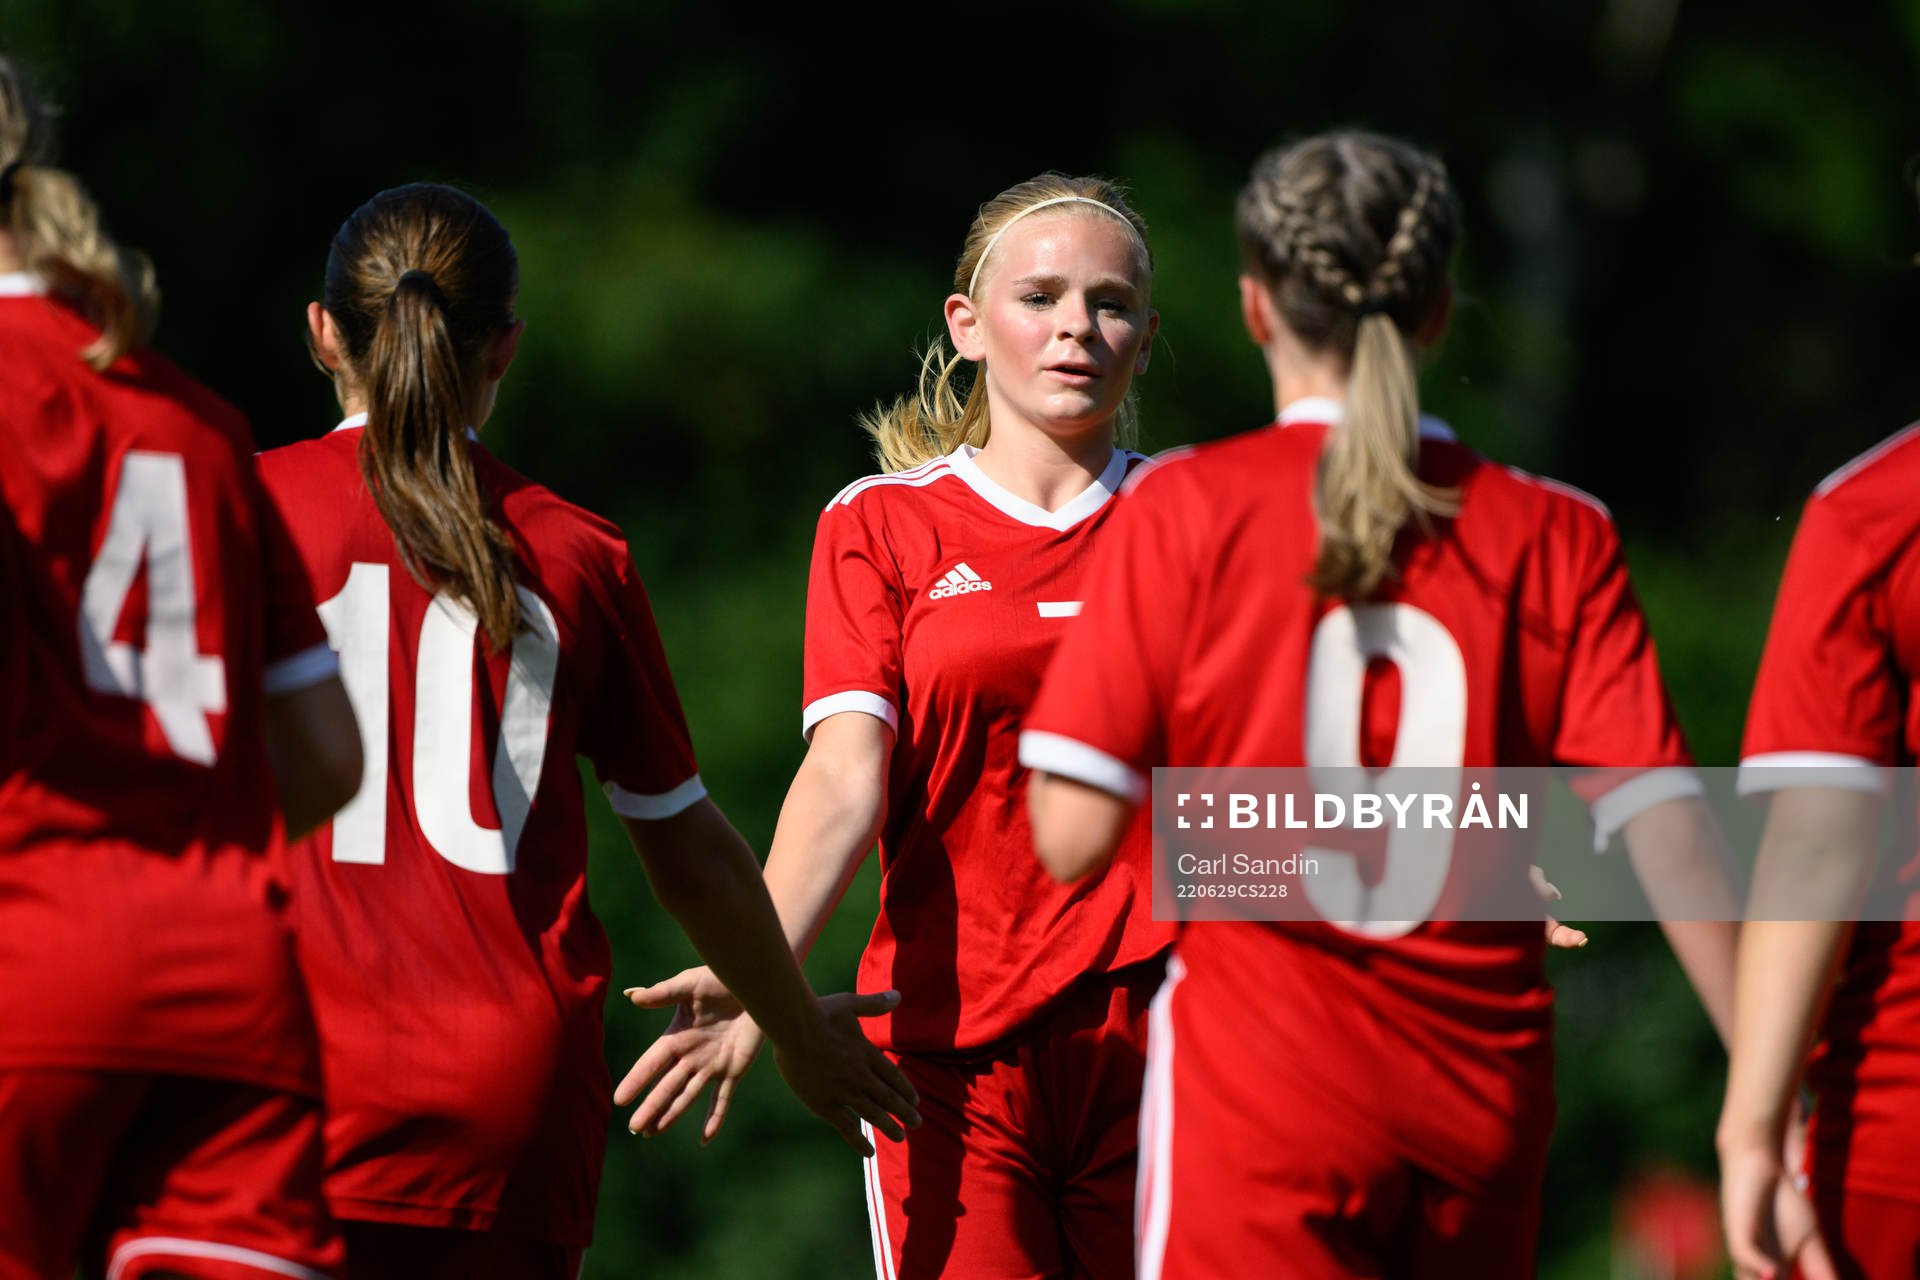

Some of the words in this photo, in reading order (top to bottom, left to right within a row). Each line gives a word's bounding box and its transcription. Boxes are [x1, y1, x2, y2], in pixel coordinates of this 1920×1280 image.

[80, 452, 227, 767] 4
[317, 562, 560, 873] 10
[929, 581, 992, 600] adidas
[1302, 603, 1466, 939] 9
